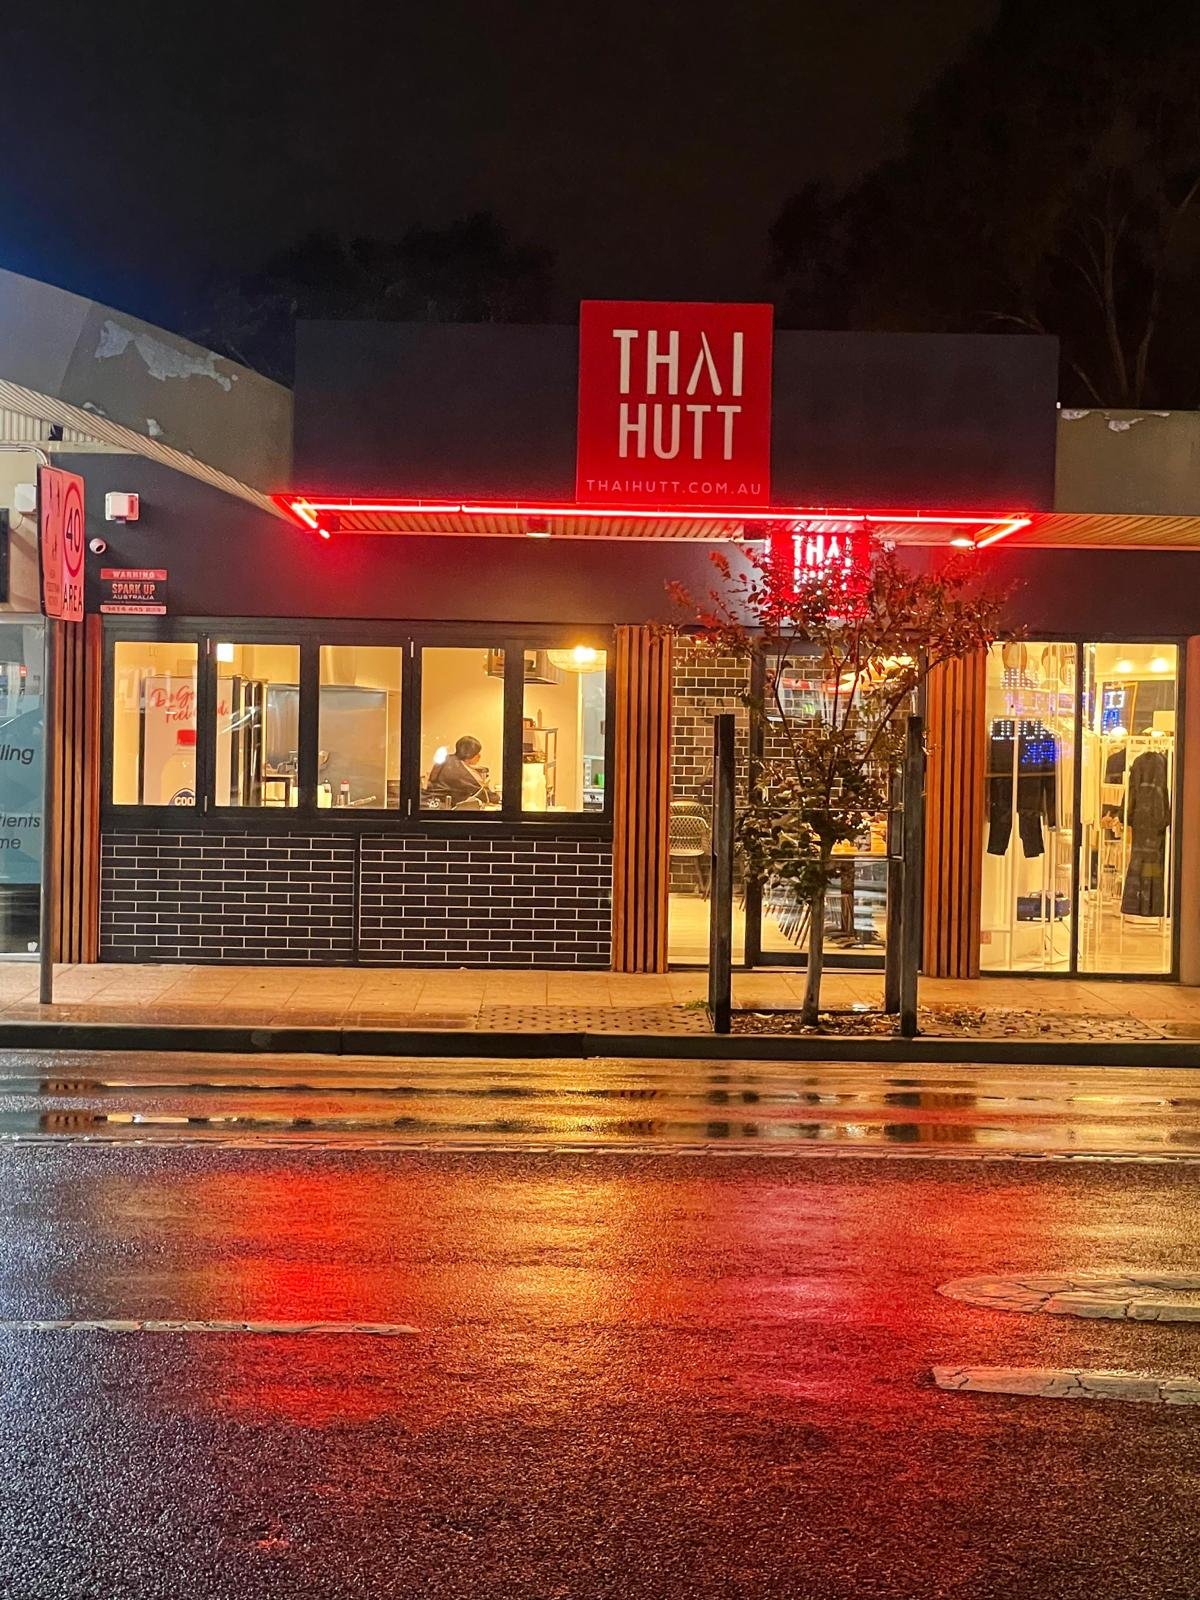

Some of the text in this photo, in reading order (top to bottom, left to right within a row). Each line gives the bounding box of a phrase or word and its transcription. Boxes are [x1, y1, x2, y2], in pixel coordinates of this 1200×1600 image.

[613, 329, 744, 397] THAI
[618, 403, 742, 460] HUTT
[586, 479, 761, 495] THAIHUTT.COM.AU
[66, 507, 81, 552] 40
[63, 583, 82, 613] AREA
[112, 583, 156, 594] SPARK UP
